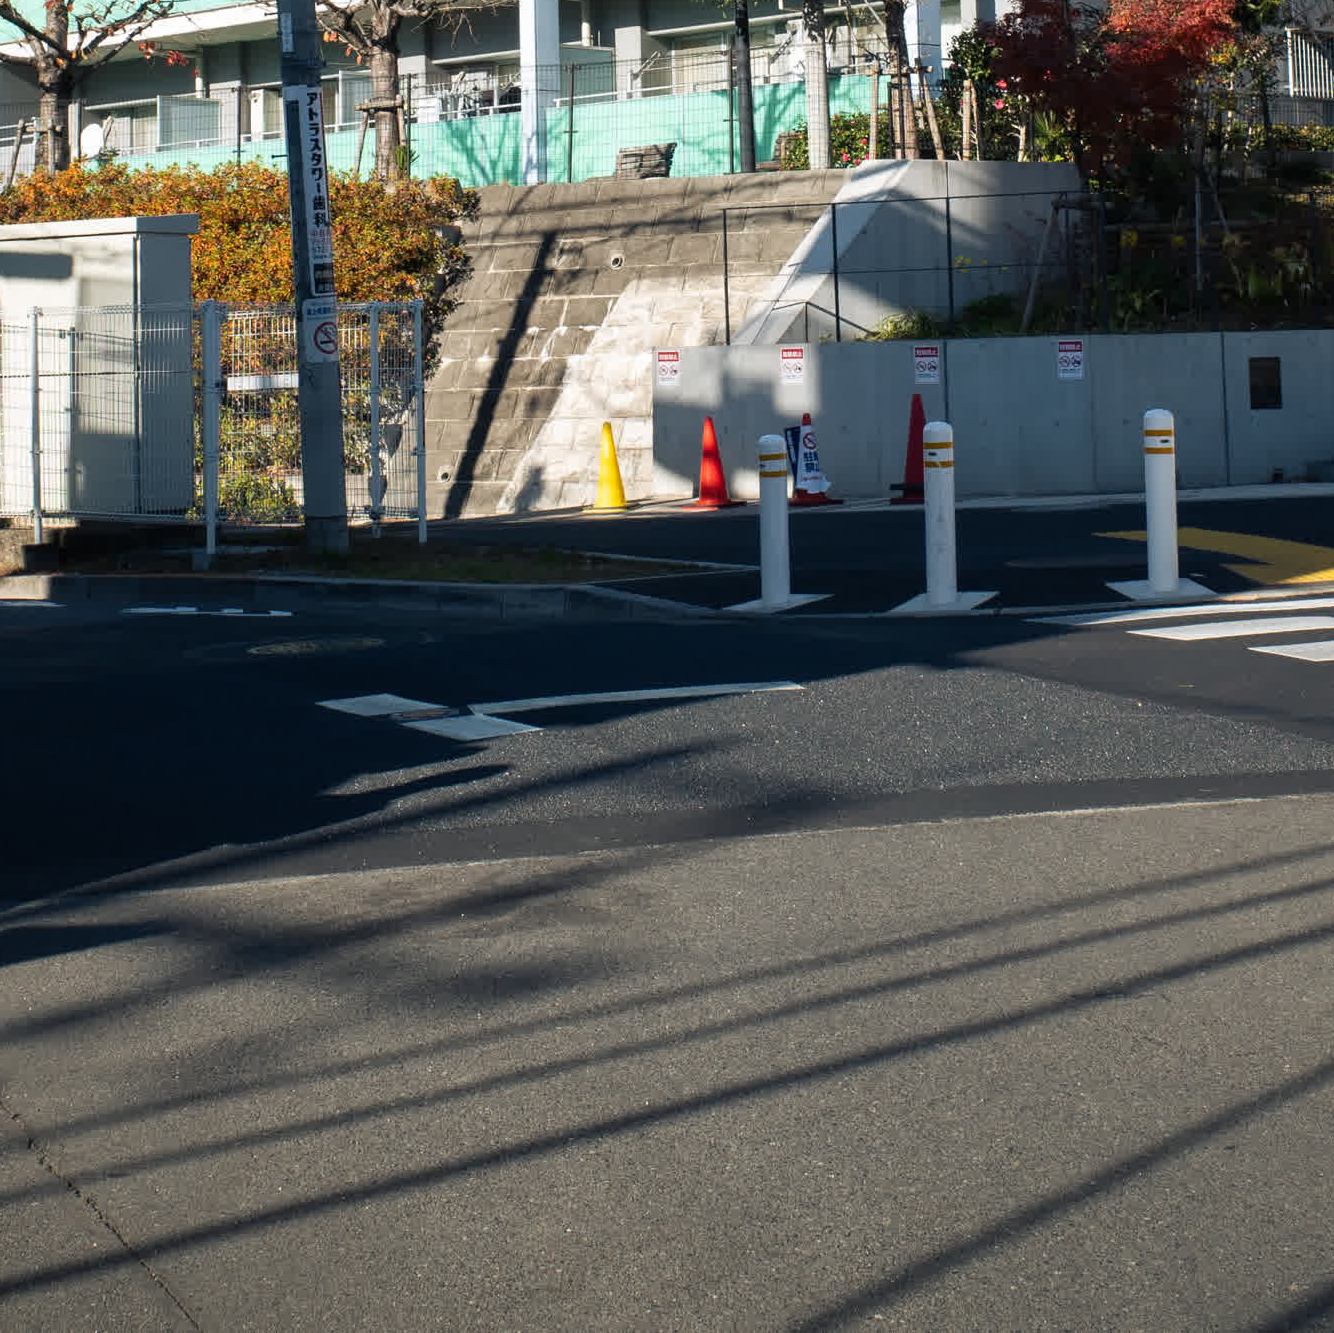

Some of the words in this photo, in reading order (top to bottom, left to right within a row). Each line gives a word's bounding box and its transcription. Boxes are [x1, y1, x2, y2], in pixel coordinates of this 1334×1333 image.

[306, 92, 325, 227] アトラスタワー歯科
